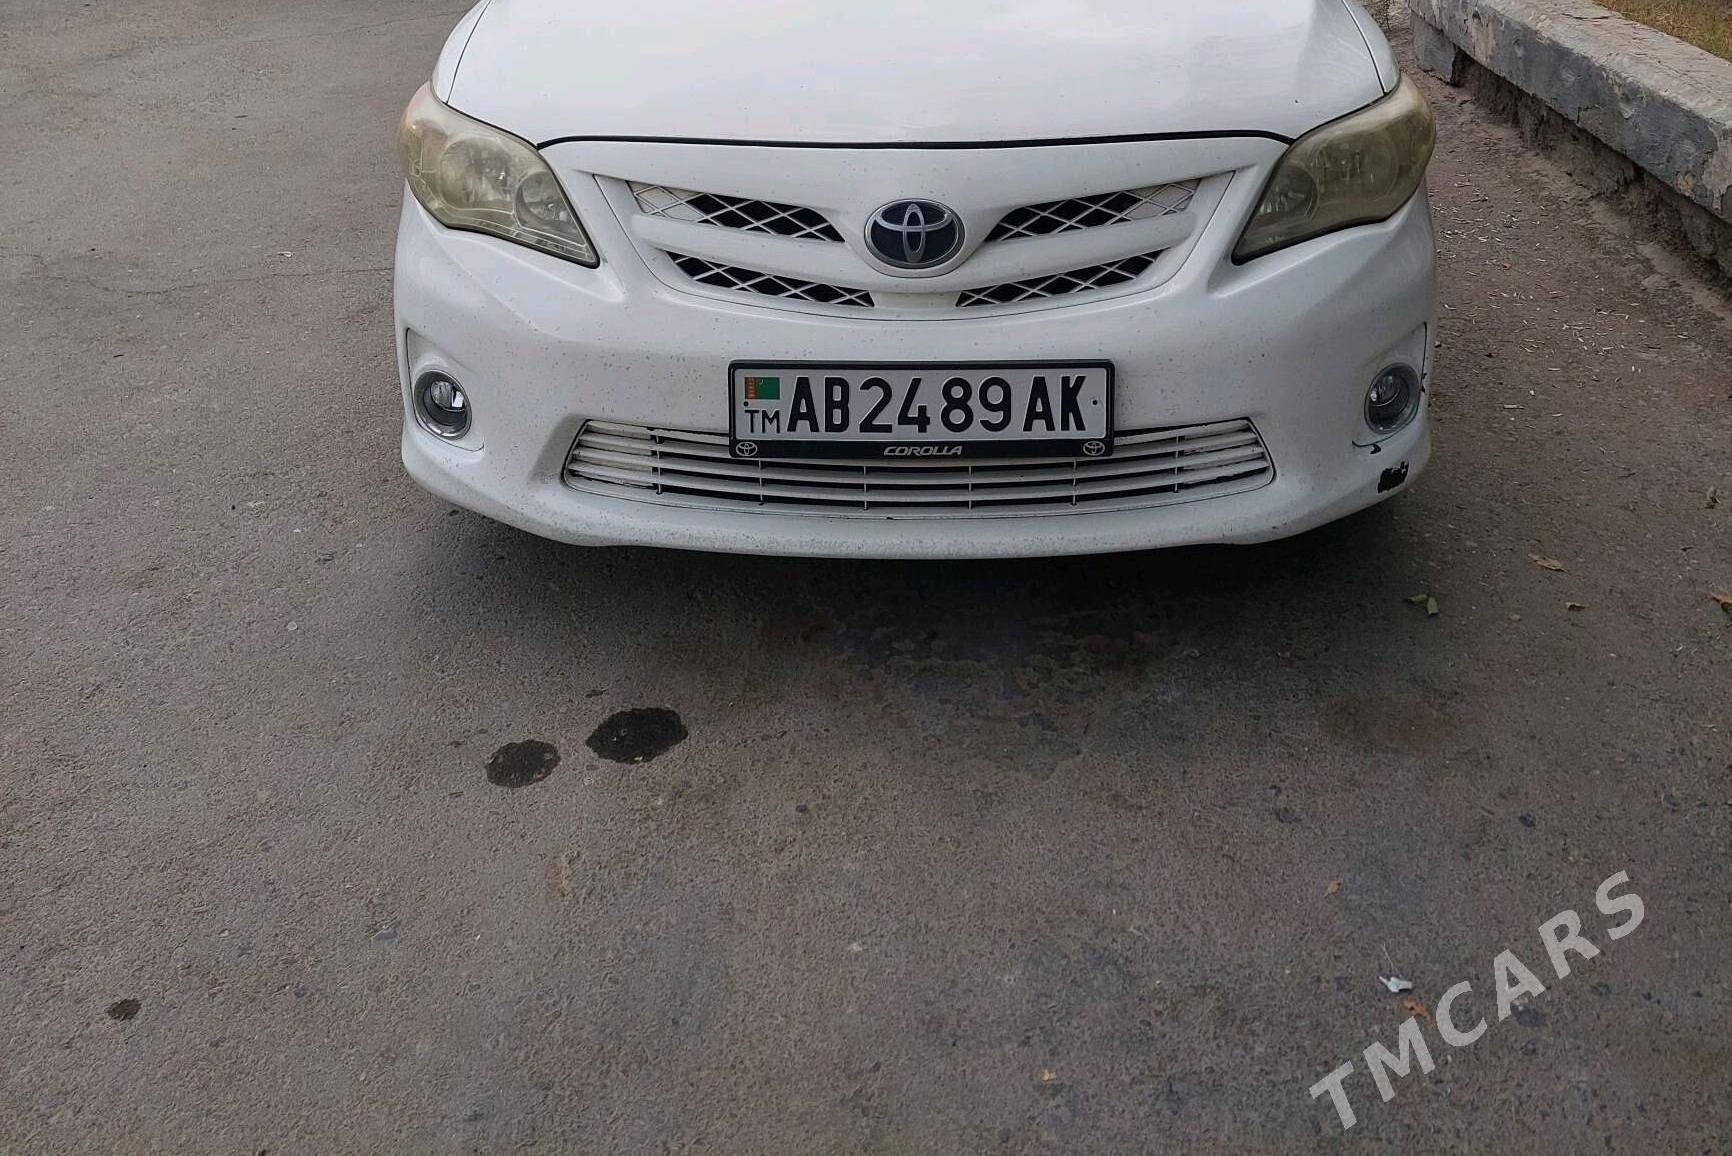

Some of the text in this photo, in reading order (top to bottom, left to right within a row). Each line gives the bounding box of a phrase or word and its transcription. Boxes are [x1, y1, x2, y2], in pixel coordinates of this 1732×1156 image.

[787, 376, 1086, 433] AB2489AK
[745, 410, 780, 433] TM
[883, 445, 963, 456] COROLLA
